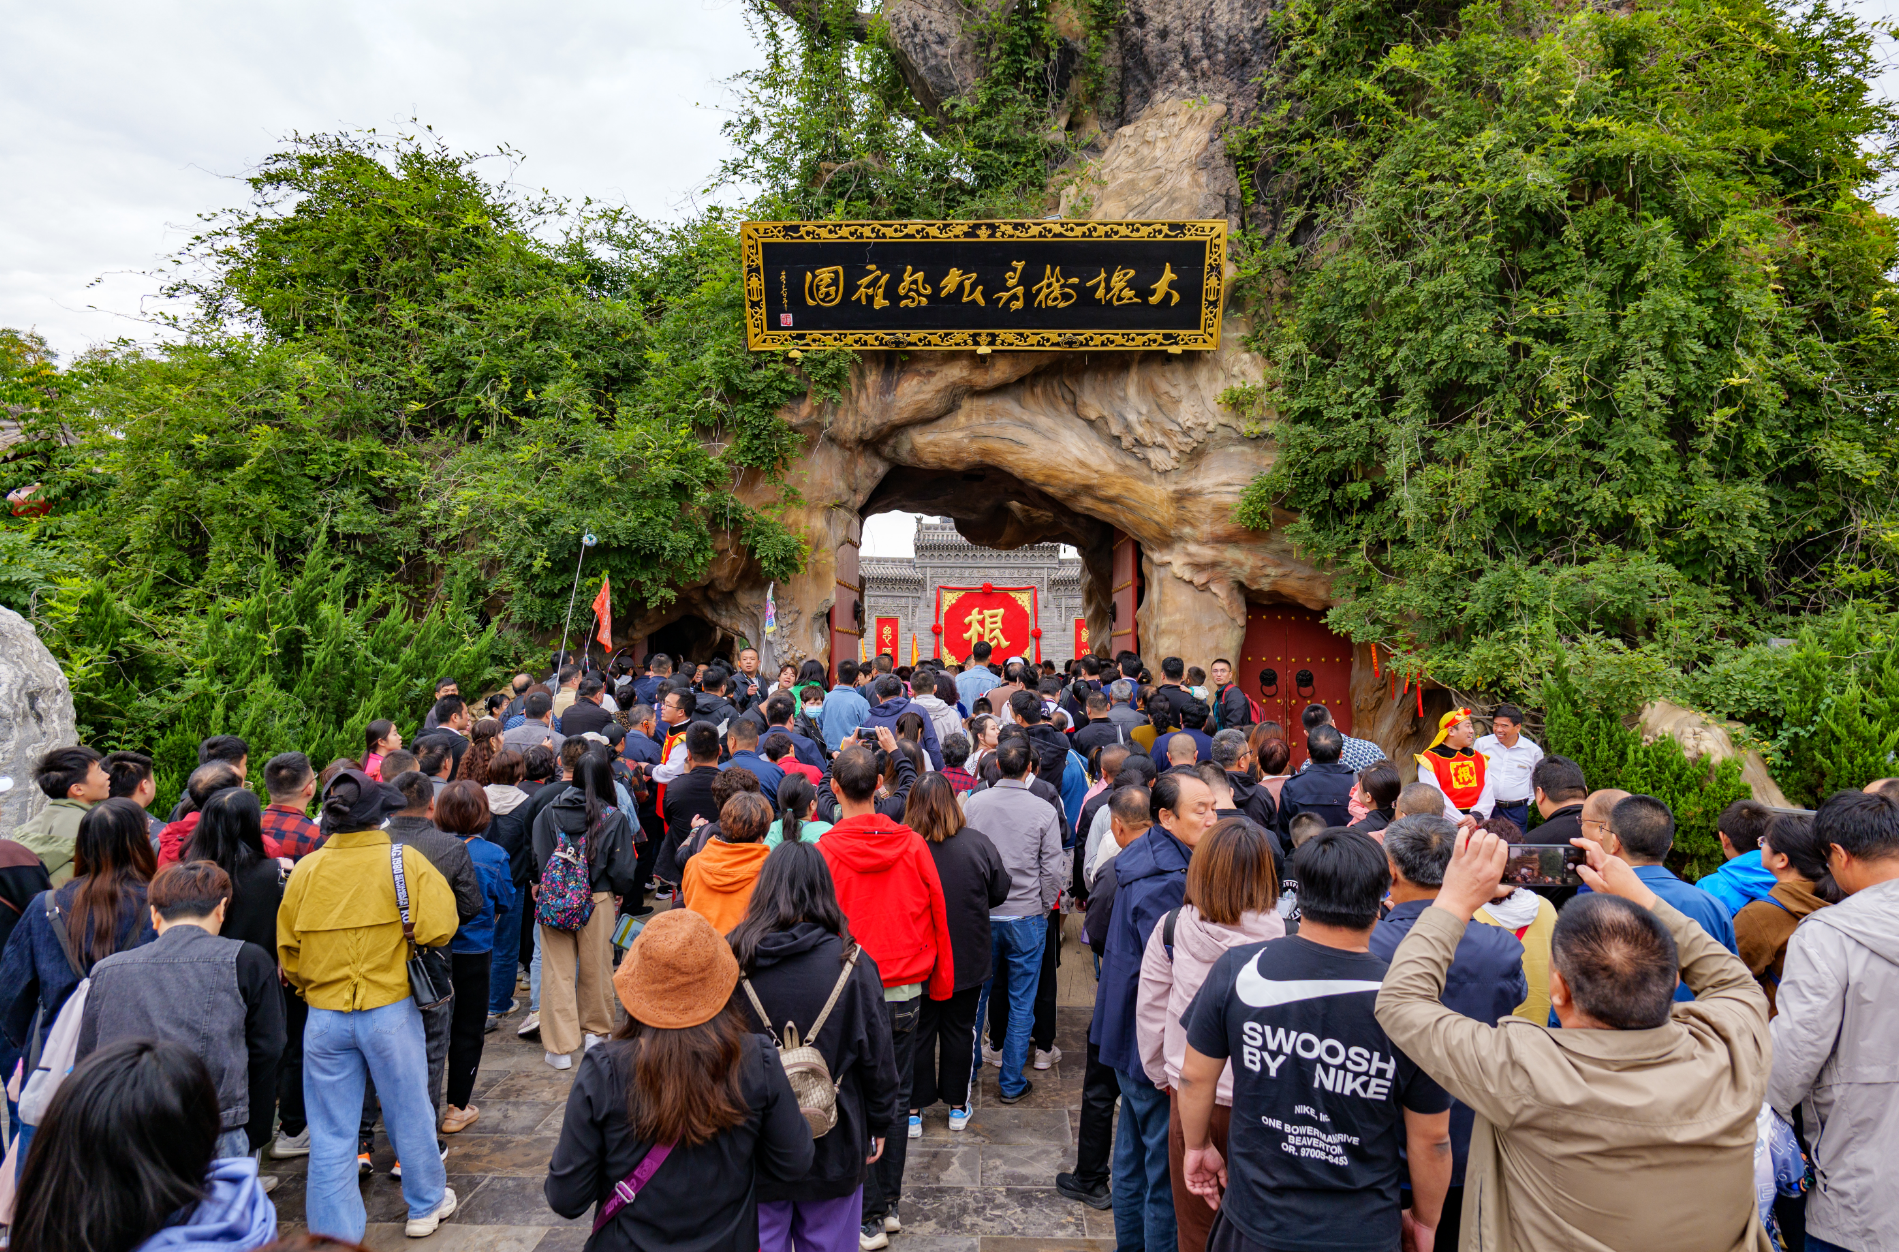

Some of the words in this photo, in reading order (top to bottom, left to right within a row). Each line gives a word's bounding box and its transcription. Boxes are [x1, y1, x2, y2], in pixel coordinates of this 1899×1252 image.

[963, 607, 1010, 652] 根
[1458, 766, 1474, 783] 根
[1243, 1021, 1396, 1079] SWOOSH
[1243, 1044, 1287, 1077] BY
[1313, 1063, 1391, 1100] NIKE
[1294, 1104, 1317, 1120] NIKE,
[1261, 1116, 1282, 1129] ONE
[1281, 1142, 1298, 1156] OR.
[1288, 1135, 1343, 1155] BEAVERTON
